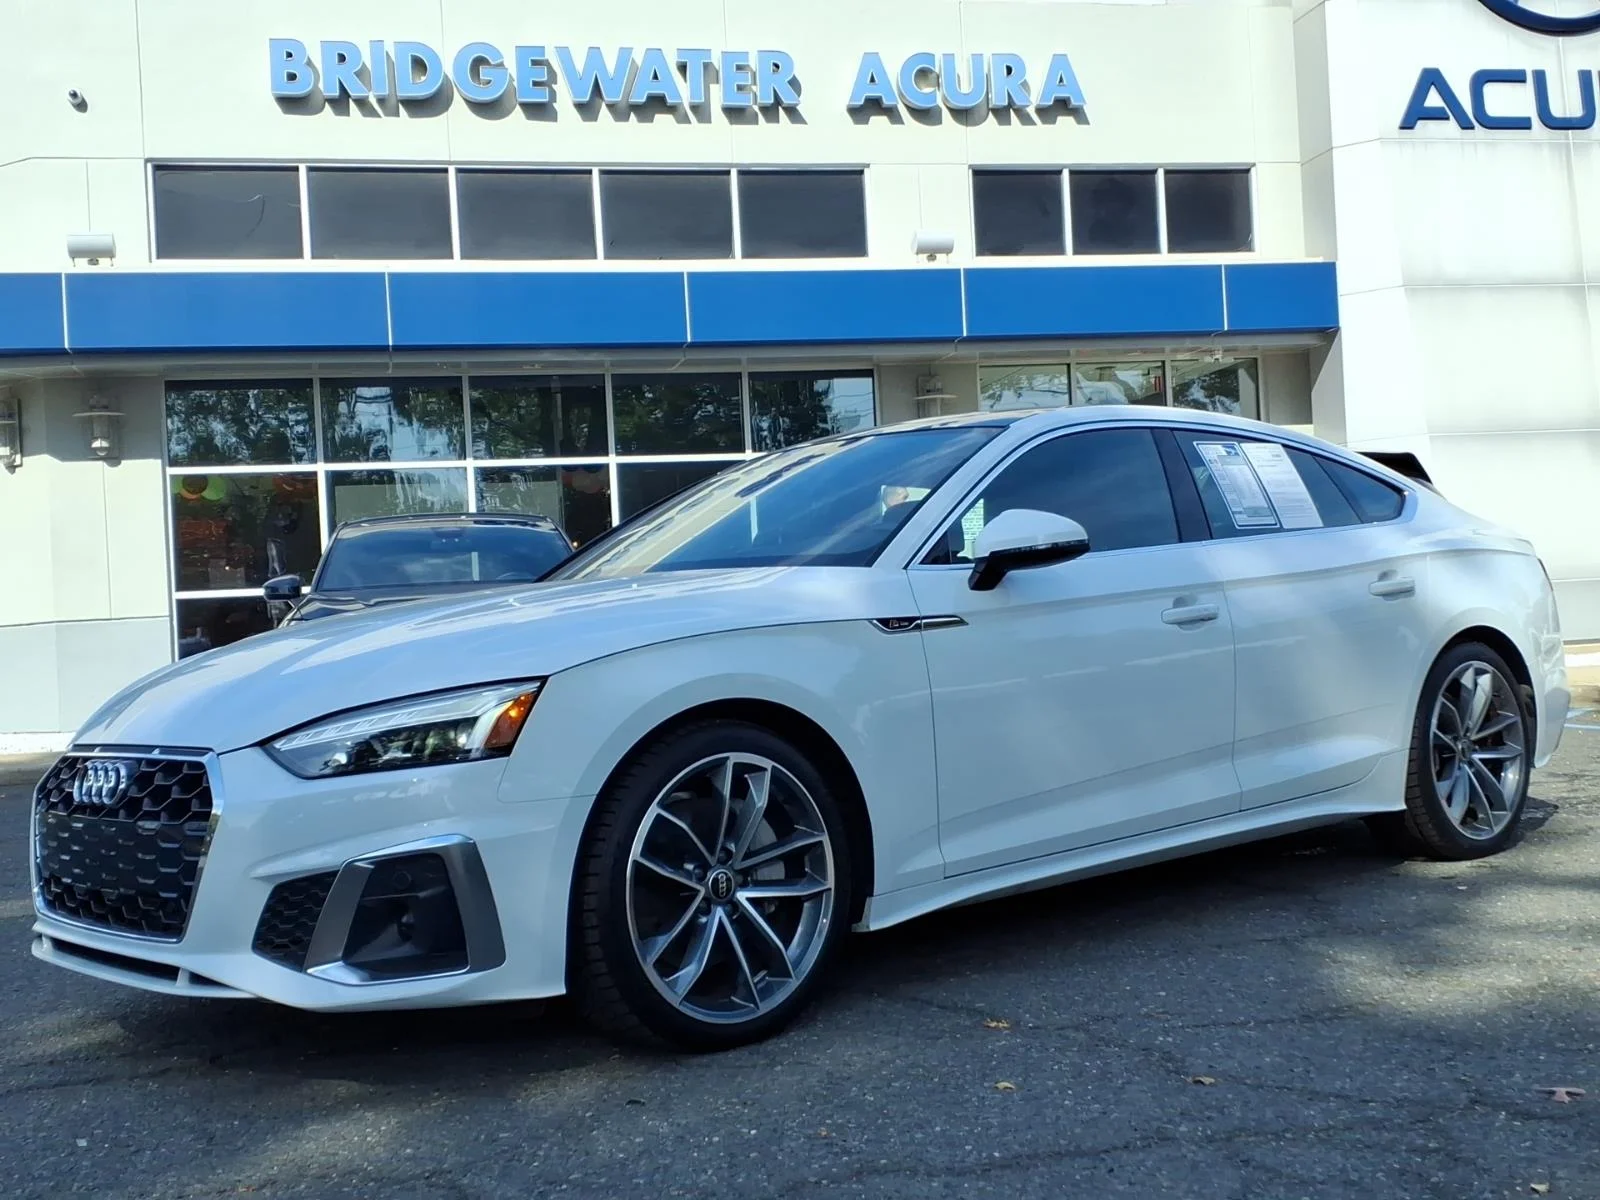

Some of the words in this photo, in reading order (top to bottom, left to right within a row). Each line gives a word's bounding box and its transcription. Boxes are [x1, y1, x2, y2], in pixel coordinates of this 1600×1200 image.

[269, 38, 801, 107] BRIDGEWATER
[847, 51, 1086, 109] ACURA
[1398, 67, 1600, 130] ACU
